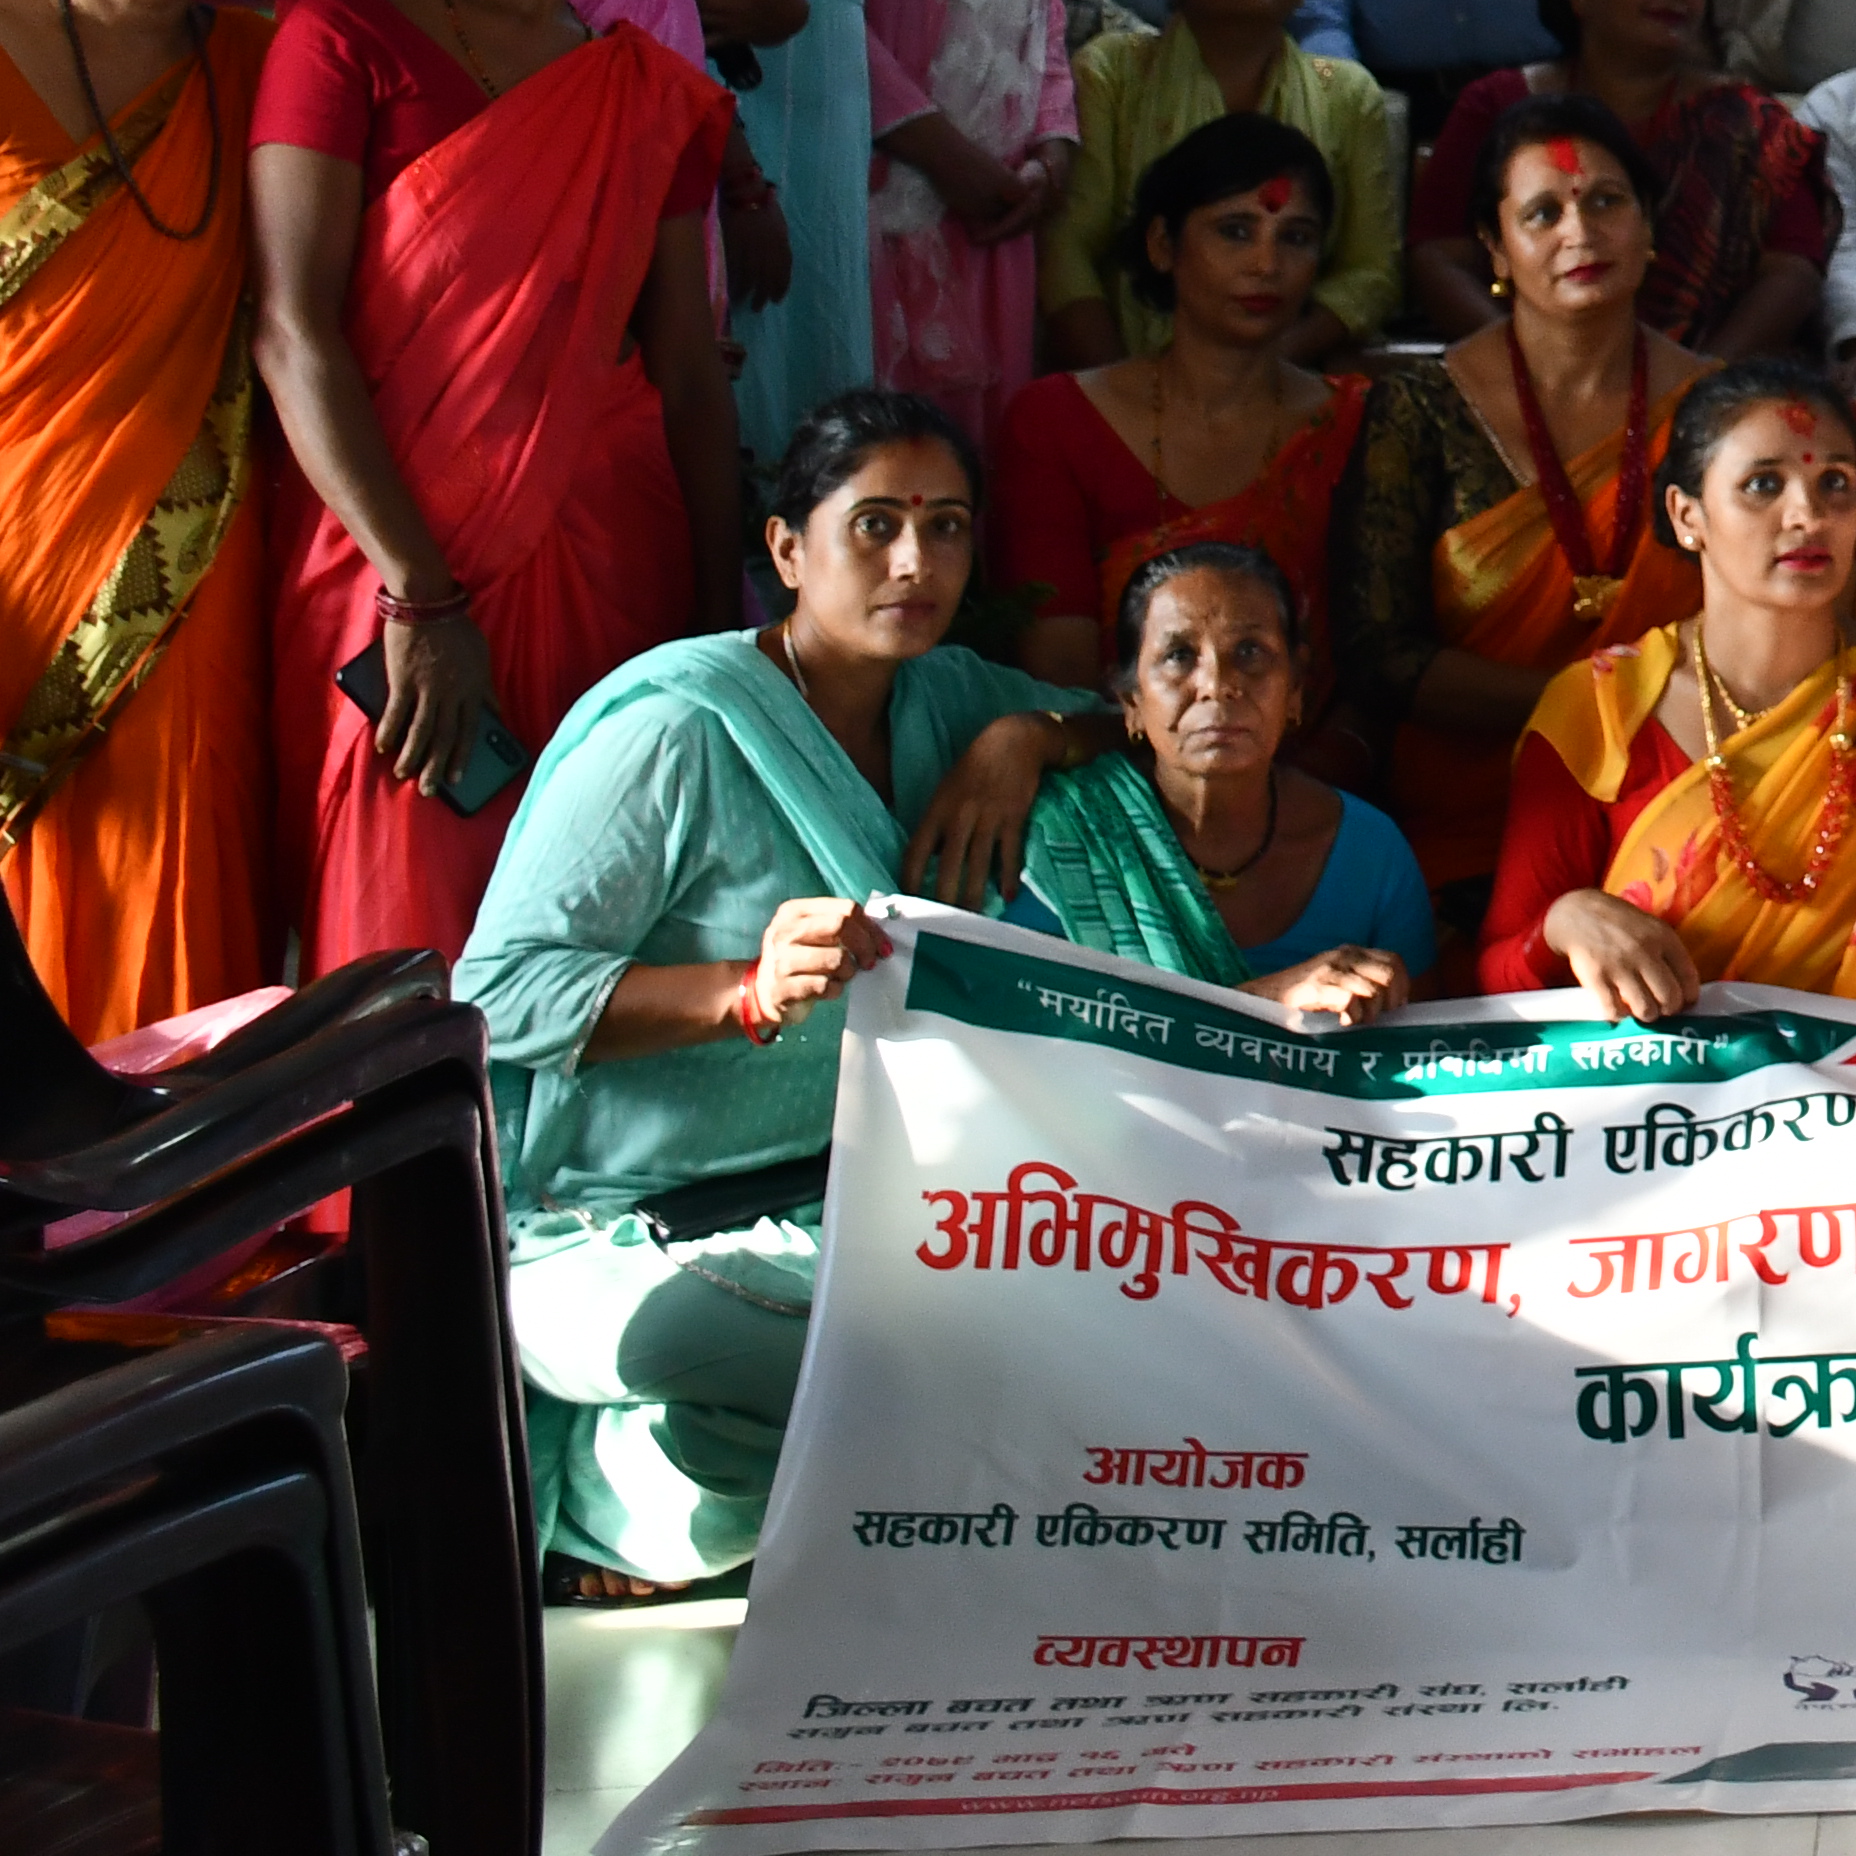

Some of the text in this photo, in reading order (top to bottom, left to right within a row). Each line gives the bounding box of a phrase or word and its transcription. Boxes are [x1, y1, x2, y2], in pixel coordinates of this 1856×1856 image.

[1195, 1023, 1340, 1078] व्यवसाय
[1360, 1051, 1382, 1081] र
[1323, 1111, 1574, 1191] सहकारी
[915, 1160, 1522, 1317] अभिमुखिकरण,
[1083, 1437, 1308, 1490] आयोजक
[852, 1502, 1526, 1565] सहकारी एकिकरण समिति, सर्लाही
[1033, 1634, 1307, 1671] व्यवस्थापन
[802, 1694, 933, 1719] जिल्ला
[946, 1697, 1036, 1716] बचत
[1049, 1695, 1128, 1712] तथा
[1250, 1682, 1399, 1704] सहकारी
[1506, 1675, 1630, 1696] सर्लाही
[1008, 1716, 1087, 1731] तथा
[1210, 1703, 1365, 1723] सहकारी
